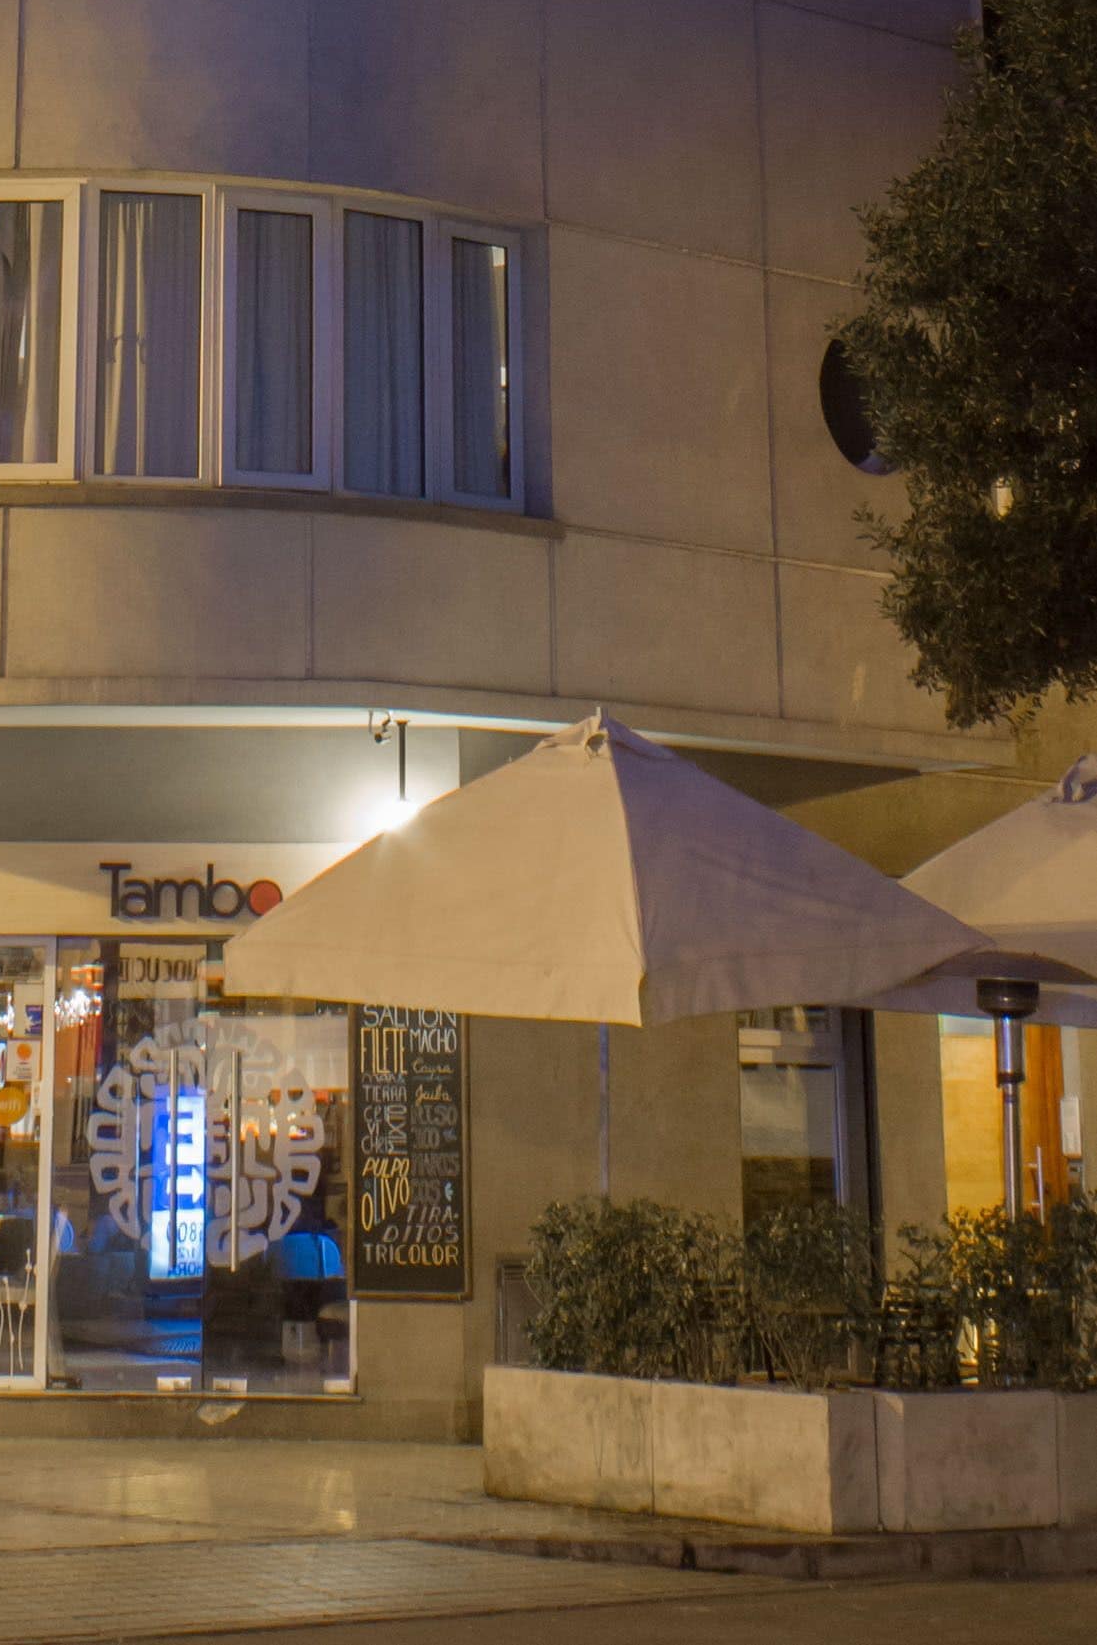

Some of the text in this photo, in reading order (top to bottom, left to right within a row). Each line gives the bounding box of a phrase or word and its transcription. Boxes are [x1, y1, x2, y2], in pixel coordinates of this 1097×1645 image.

[99, 862, 283, 918] Tambo
[360, 1027, 408, 1075] FILETE
[409, 1028, 457, 1054] MACHO
[362, 1157, 410, 1179] PULPO
[383, 1224, 459, 1244] DITOS
[363, 1242, 459, 1267] TRICOLOR
